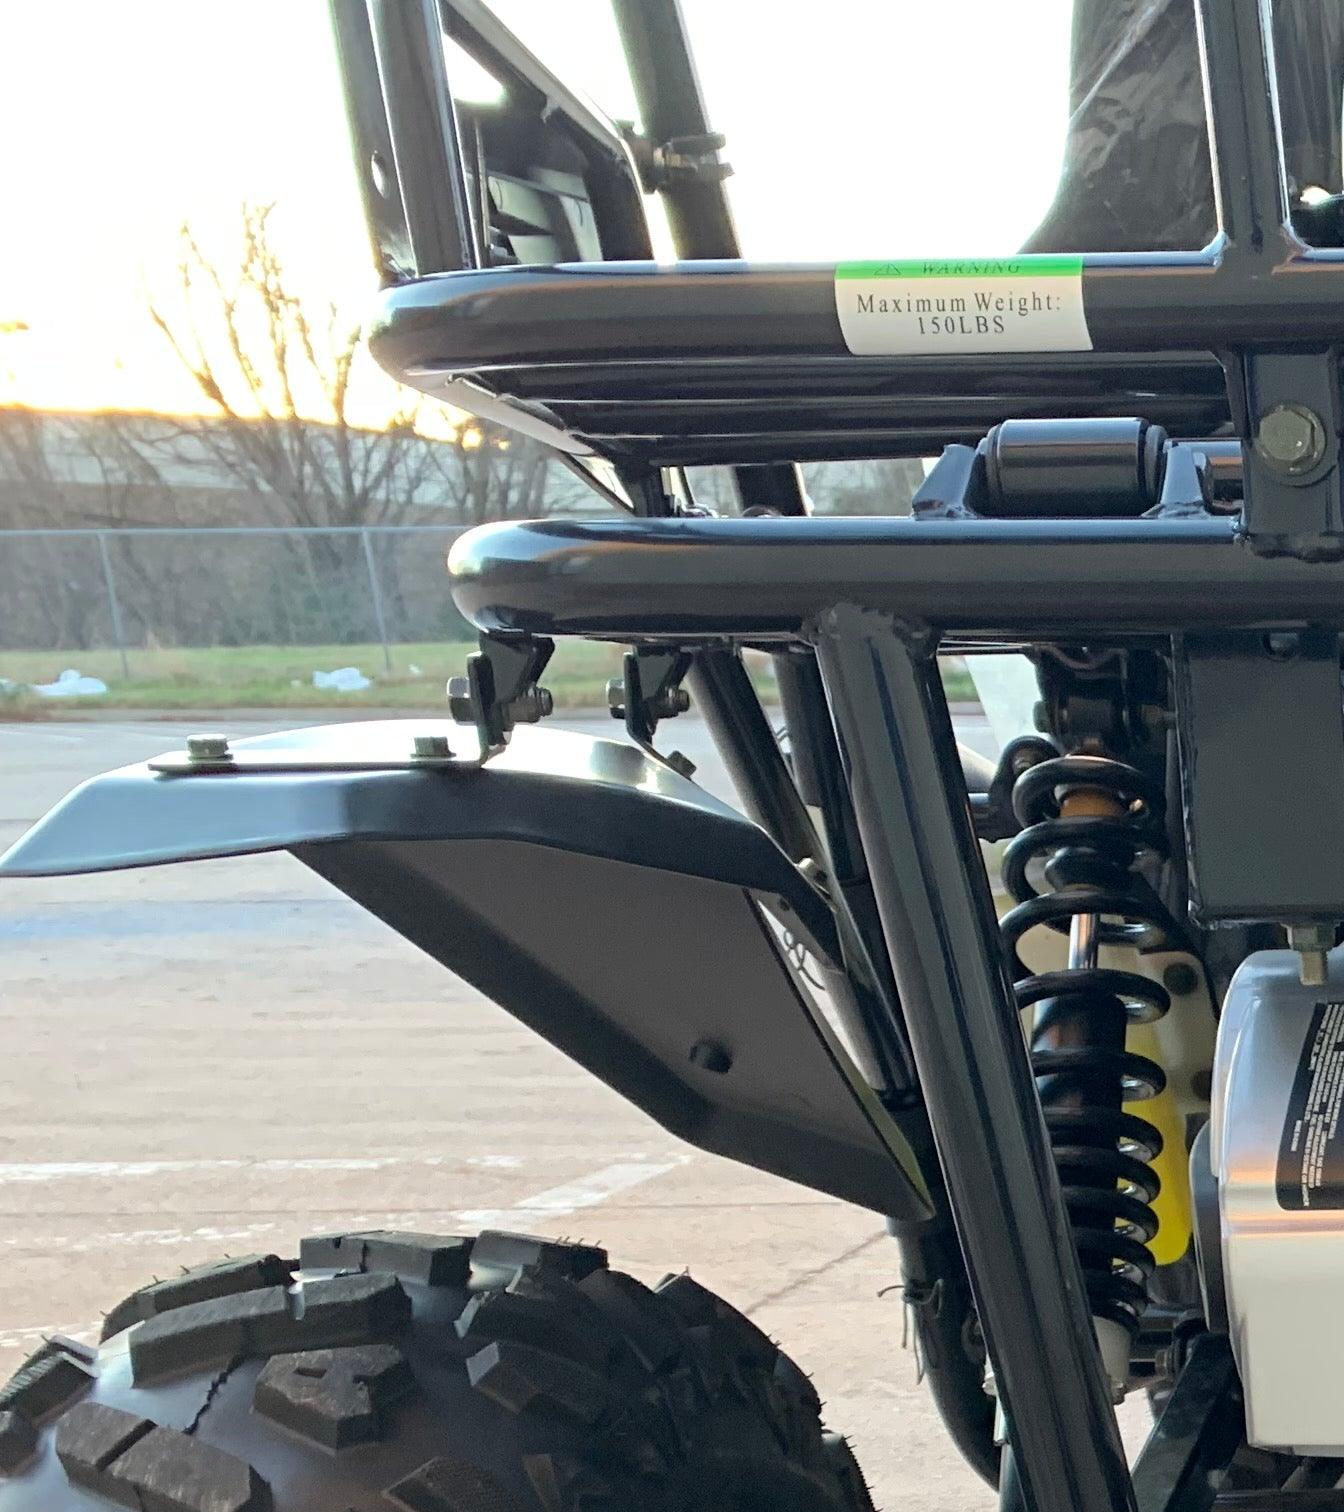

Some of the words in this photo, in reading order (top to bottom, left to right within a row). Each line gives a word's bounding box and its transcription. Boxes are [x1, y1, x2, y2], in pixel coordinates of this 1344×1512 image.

[922, 260, 1021, 274] WARNING
[857, 292, 966, 314] Maximum
[974, 291, 1061, 316] Weight:
[919, 315, 1005, 336] 150LBS
